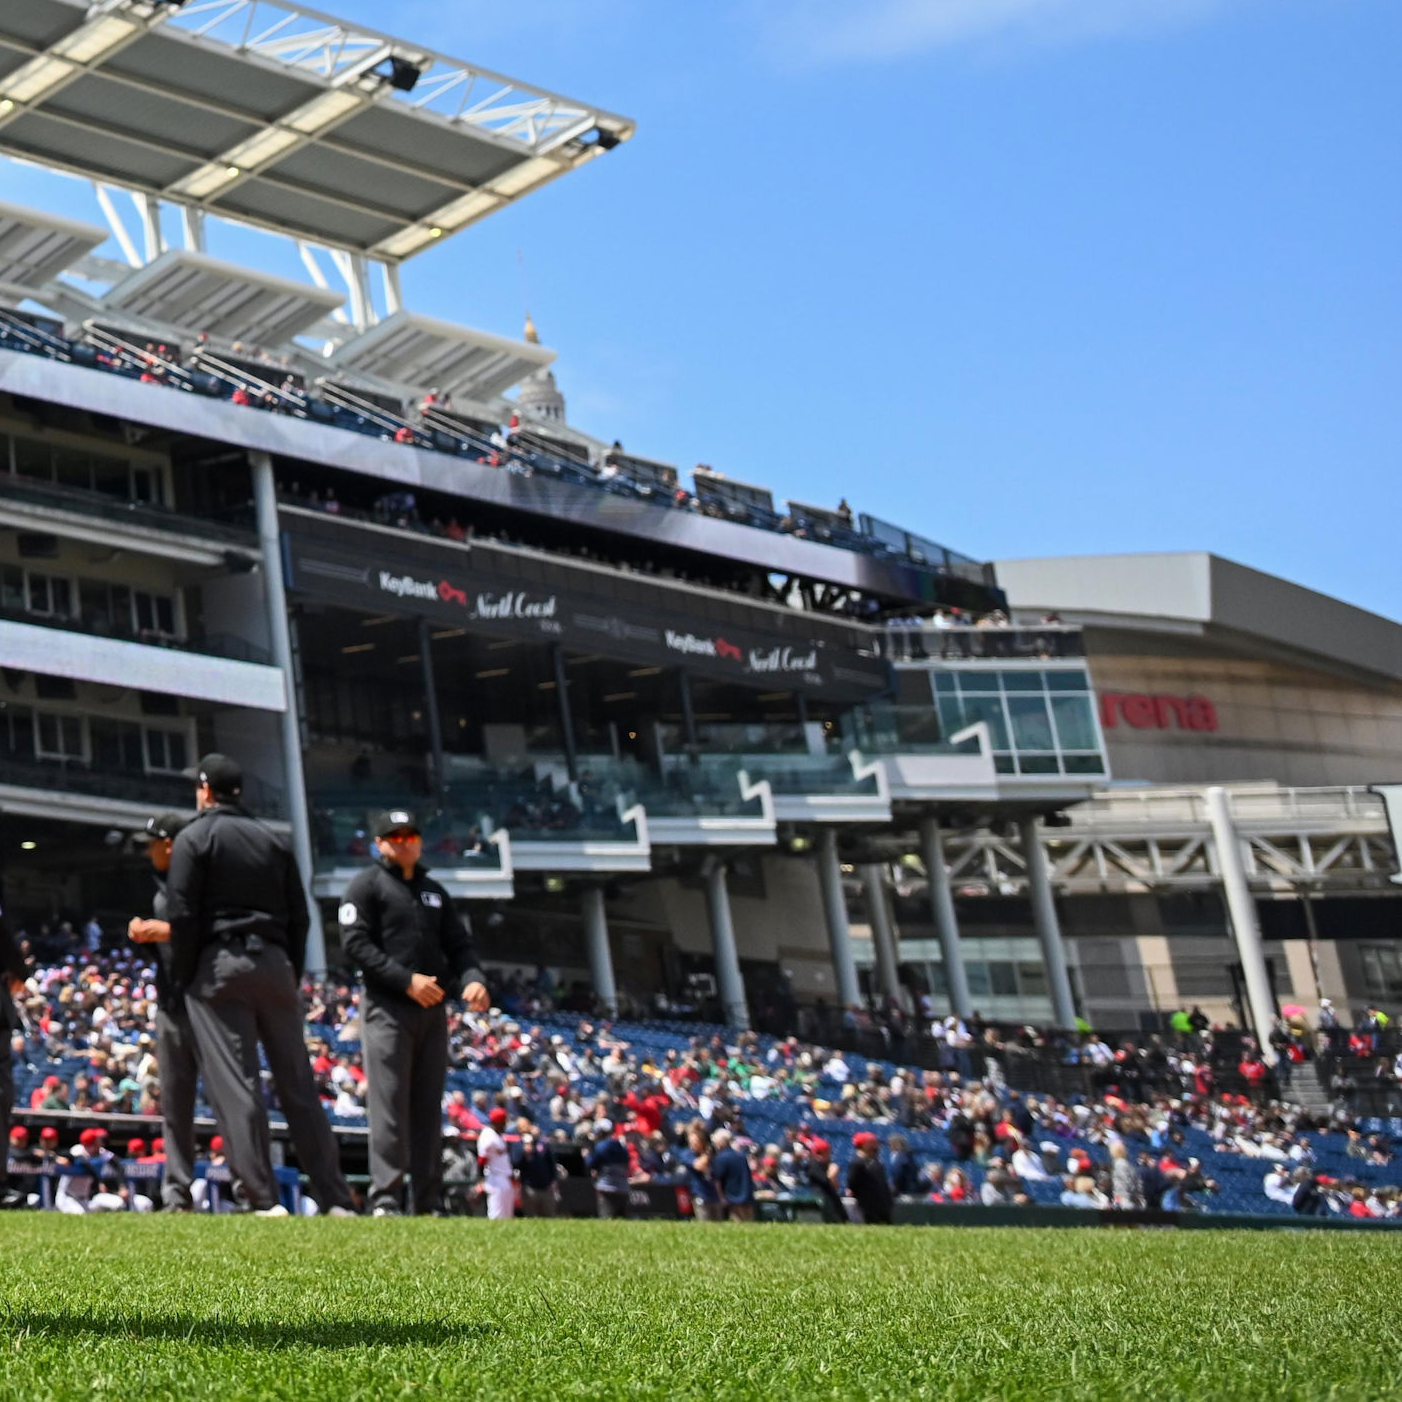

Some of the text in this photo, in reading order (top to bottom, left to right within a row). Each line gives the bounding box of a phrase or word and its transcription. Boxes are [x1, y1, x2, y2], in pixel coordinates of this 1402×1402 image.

[379, 570, 439, 600] KeyBank
[665, 629, 717, 656] KeyBank
[1100, 692, 1219, 730] rena
